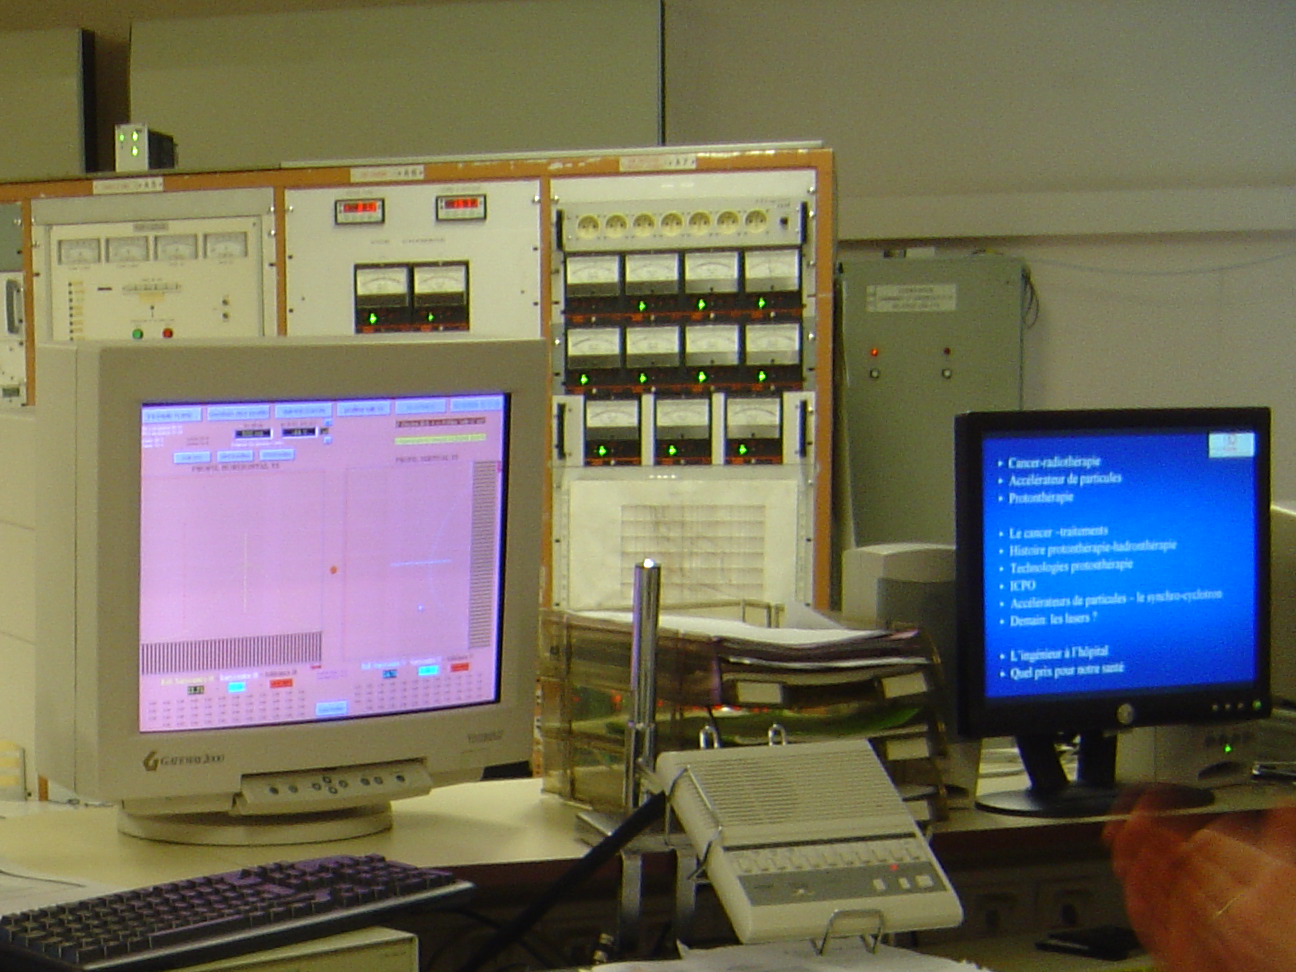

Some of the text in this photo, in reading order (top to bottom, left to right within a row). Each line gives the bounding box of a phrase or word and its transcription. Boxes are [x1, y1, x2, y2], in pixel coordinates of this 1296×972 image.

[1067, 471, 1078, 485] de
[1079, 471, 1123, 488] particules
[1009, 528, 1022, 539] Le
[1072, 595, 1084, 606] de
[1050, 613, 1063, 625] les
[1010, 667, 1033, 681] Quel
[1054, 666, 1075, 680] pour
